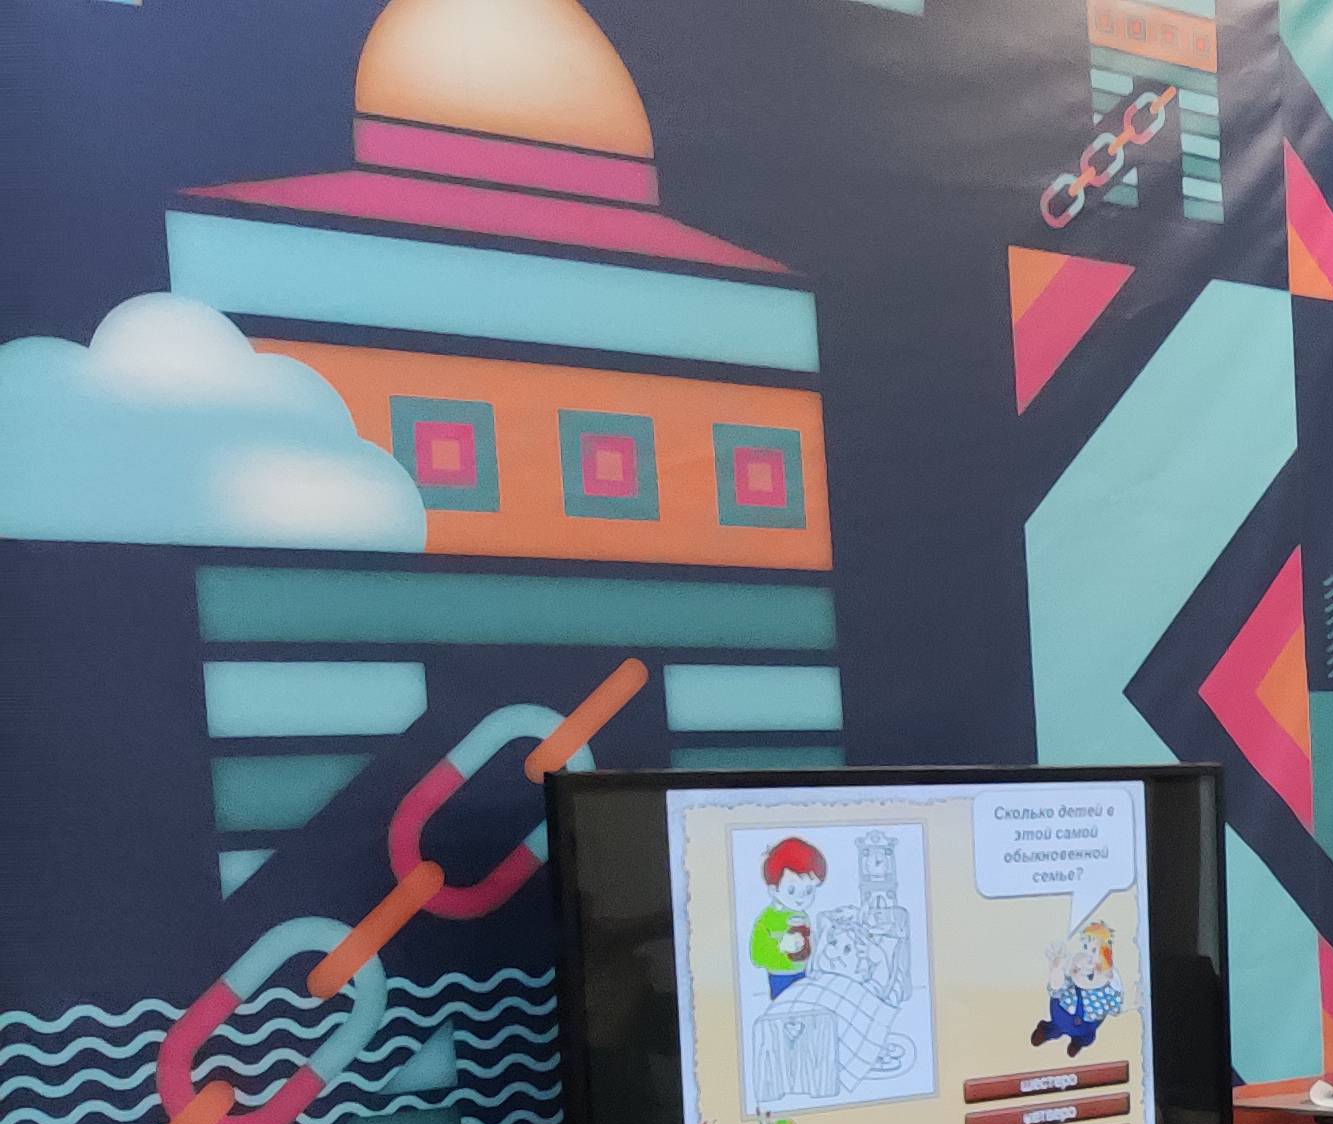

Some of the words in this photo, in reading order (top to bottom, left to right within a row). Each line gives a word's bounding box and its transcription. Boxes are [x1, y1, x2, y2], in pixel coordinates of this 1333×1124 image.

[993, 805, 1055, 820] Сколько
[1058, 803, 1103, 818] детей
[1106, 805, 1115, 817] в
[1013, 826, 1051, 842] этой
[1055, 826, 1099, 840] самой
[1003, 847, 1110, 864] обыкновенной
[1031, 866, 1084, 883] семье?
